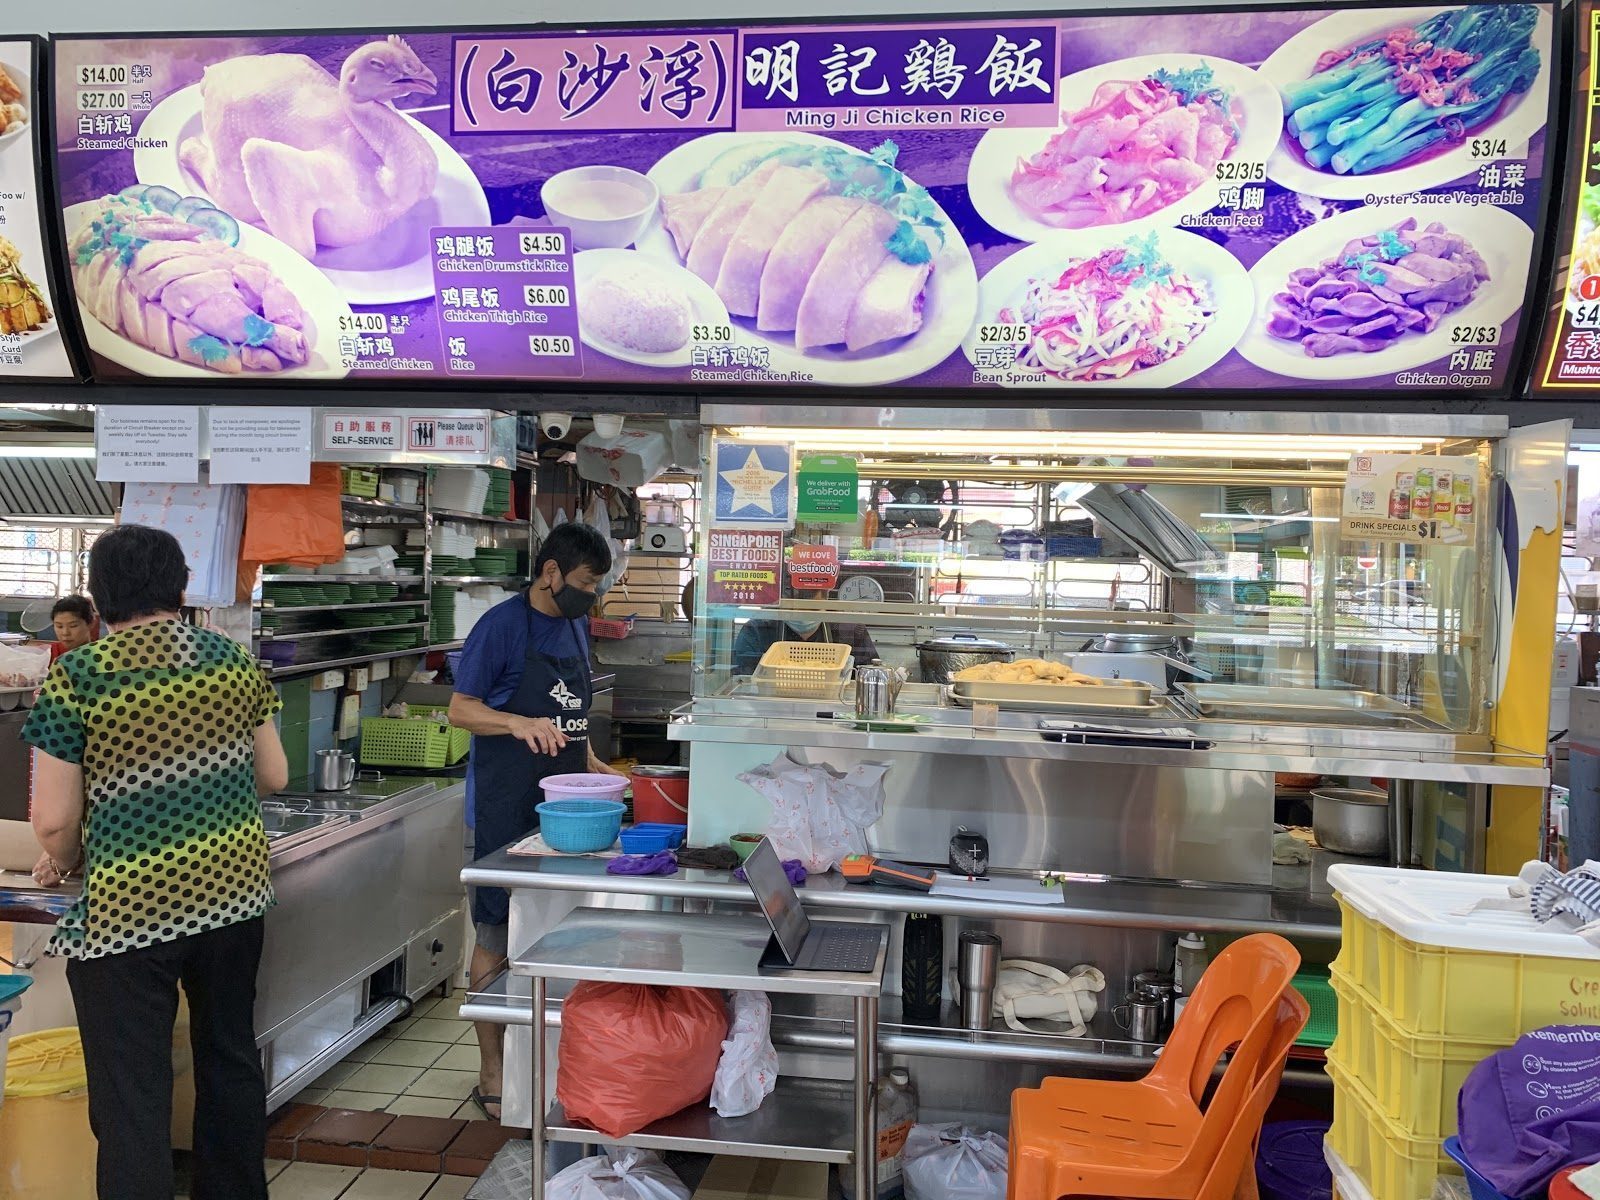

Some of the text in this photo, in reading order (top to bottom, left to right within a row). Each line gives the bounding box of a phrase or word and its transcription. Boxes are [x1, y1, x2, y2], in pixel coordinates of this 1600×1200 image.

[81, 66, 126, 84] $14.00
[131, 64, 153, 77] 半只
[459, 38, 727, 127] (白沙浮)
[81, 92, 126, 109] $27.00
[131, 90, 153, 103] 一只
[78, 113, 132, 135] 白斩鸡
[786, 107, 1006, 129] Ming Ji Chicken Rice
[78, 137, 168, 149] Steamed Chicken
[1470, 138, 1508, 158] $3/4
[1215, 162, 1265, 181] $2/3/5
[1478, 163, 1527, 188] 油菜
[1218, 187, 1265, 210] 鸡脚
[1364, 192, 1524, 207] Oyster Sauce Vegetable
[1180, 213, 1264, 228] Chicken Feet
[435, 235, 495, 257] 鸡腿饭
[522, 235, 562, 252] $4.50
[438, 259, 568, 272] Chicken Drumstick Rice
[1589, 279, 1598, 296] 1
[441, 287, 500, 309] 鸡尾饭
[527, 287, 566, 304] $6.00
[338, 315, 384, 332] $14.00
[389, 315, 410, 327] 半只
[443, 310, 547, 325] Chicken Thigh Rice
[0, 335, 21, 345] Style
[692, 325, 731, 341] $3.50
[979, 325, 1028, 343] $2/3/5
[1450, 325, 1498, 344] $2/$3
[2, 345, 22, 353] Curd
[338, 336, 395, 357] 白斩鸡
[447, 336, 468, 357] 饭
[532, 337, 571, 354] $0.50
[342, 358, 433, 371] Steamed Chicken
[691, 346, 771, 368] 白斩鸡饭
[974, 348, 1017, 369] 豆芽
[1449, 350, 1497, 371] 内脏
[450, 359, 475, 371] Rice
[691, 369, 814, 383] Steamed Chicken Rice
[973, 371, 1047, 386] Bean Sprout
[1395, 373, 1491, 387] Chicken Organ
[334, 420, 392, 433] 自助服務
[437, 421, 484, 432] Please Queue Up
[332, 436, 394, 445] SELF-SERVICE
[445, 434, 475, 446] 请排队
[806, 487, 850, 496] GrabFood
[1350, 521, 1375, 530] DRINK
[1376, 522, 1417, 532] SPECIALS
[710, 533, 779, 548] SINGAPORE
[711, 549, 777, 562] BEST FOODS
[798, 551, 811, 559] WE
[734, 571, 748, 579] RATED
[789, 561, 838, 576] bestfoody
[733, 591, 755, 600] 2018
